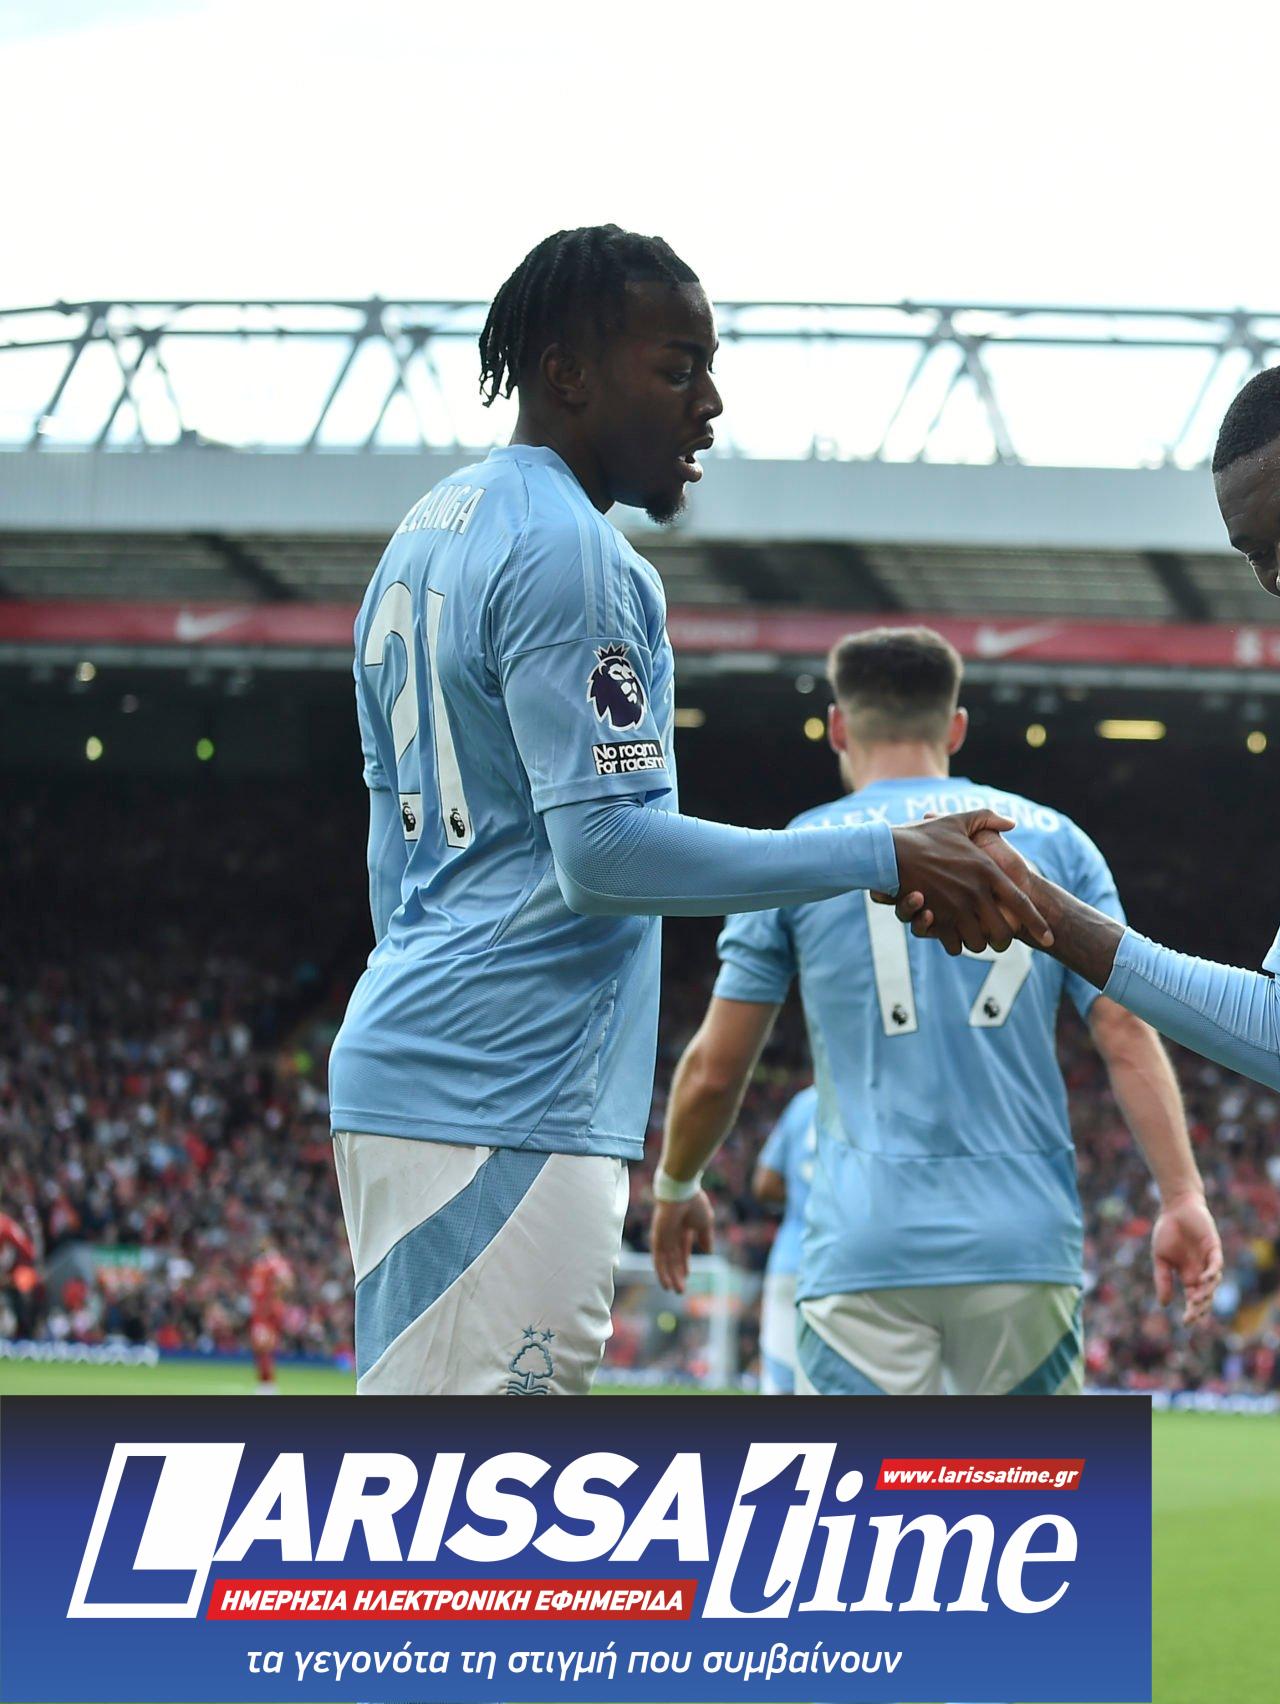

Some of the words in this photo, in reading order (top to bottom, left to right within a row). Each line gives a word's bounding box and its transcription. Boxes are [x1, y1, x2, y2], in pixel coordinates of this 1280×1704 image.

[364, 581, 474, 849] 21
[592, 744, 617, 760] No
[618, 743, 658, 758] room
[620, 756, 665, 772] racism
